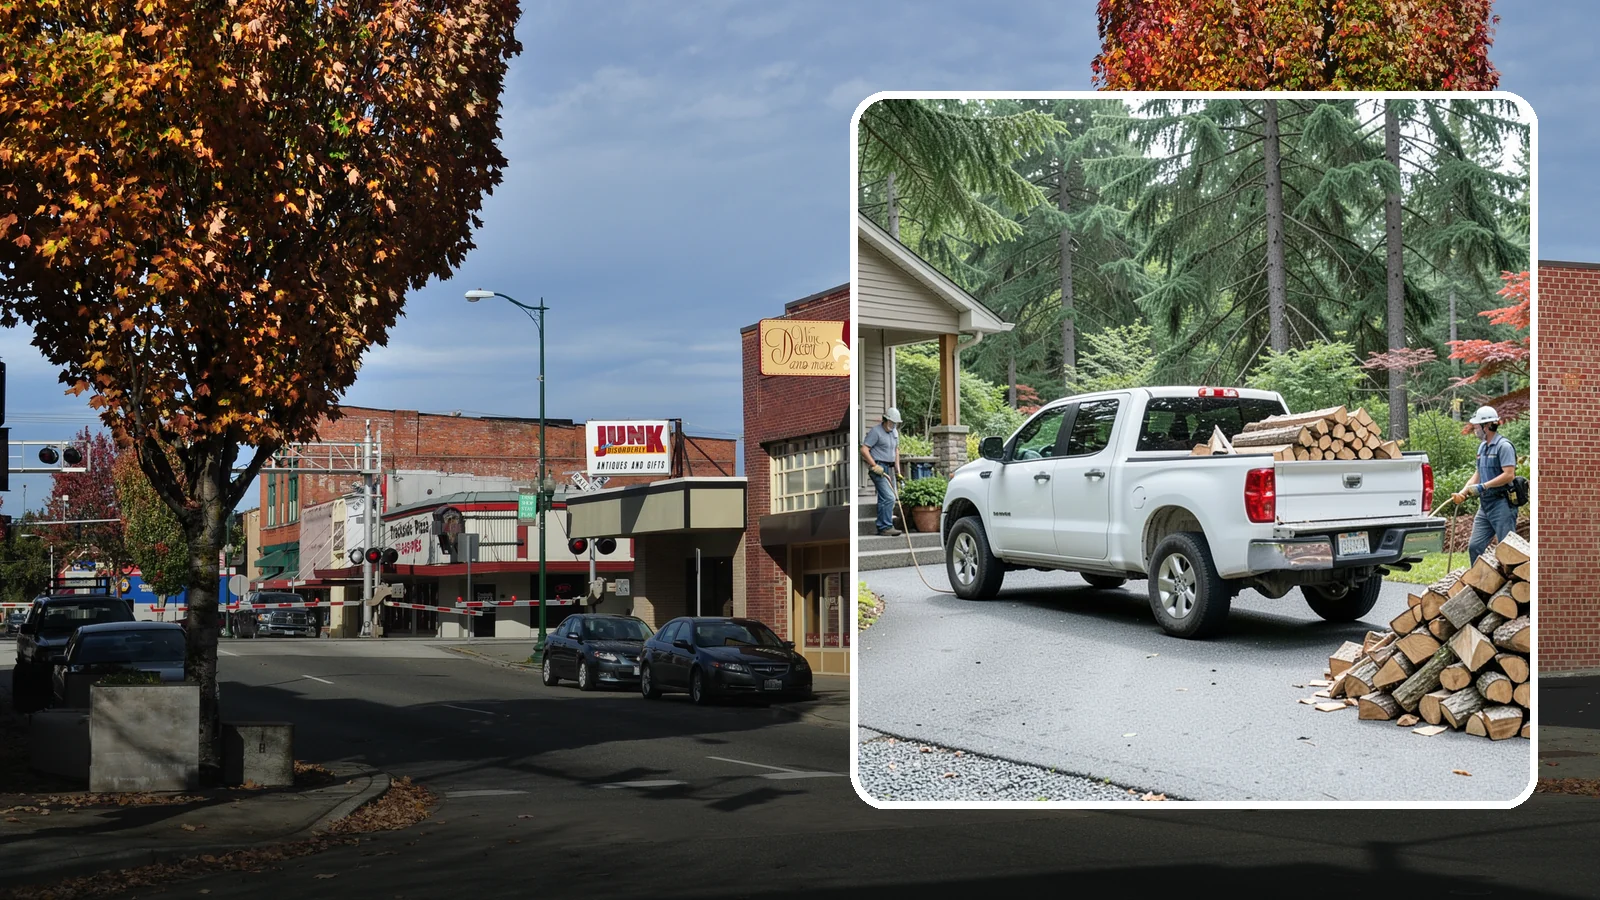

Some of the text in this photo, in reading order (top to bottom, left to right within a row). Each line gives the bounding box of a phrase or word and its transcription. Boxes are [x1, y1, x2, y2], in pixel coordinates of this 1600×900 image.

[595, 425, 664, 457] JUNK
[607, 446, 646, 454] DISORDERLY
[596, 460, 665, 470] ANTIQUES AND GIFTS
[390, 519, 428, 539] Trackside Pizza
